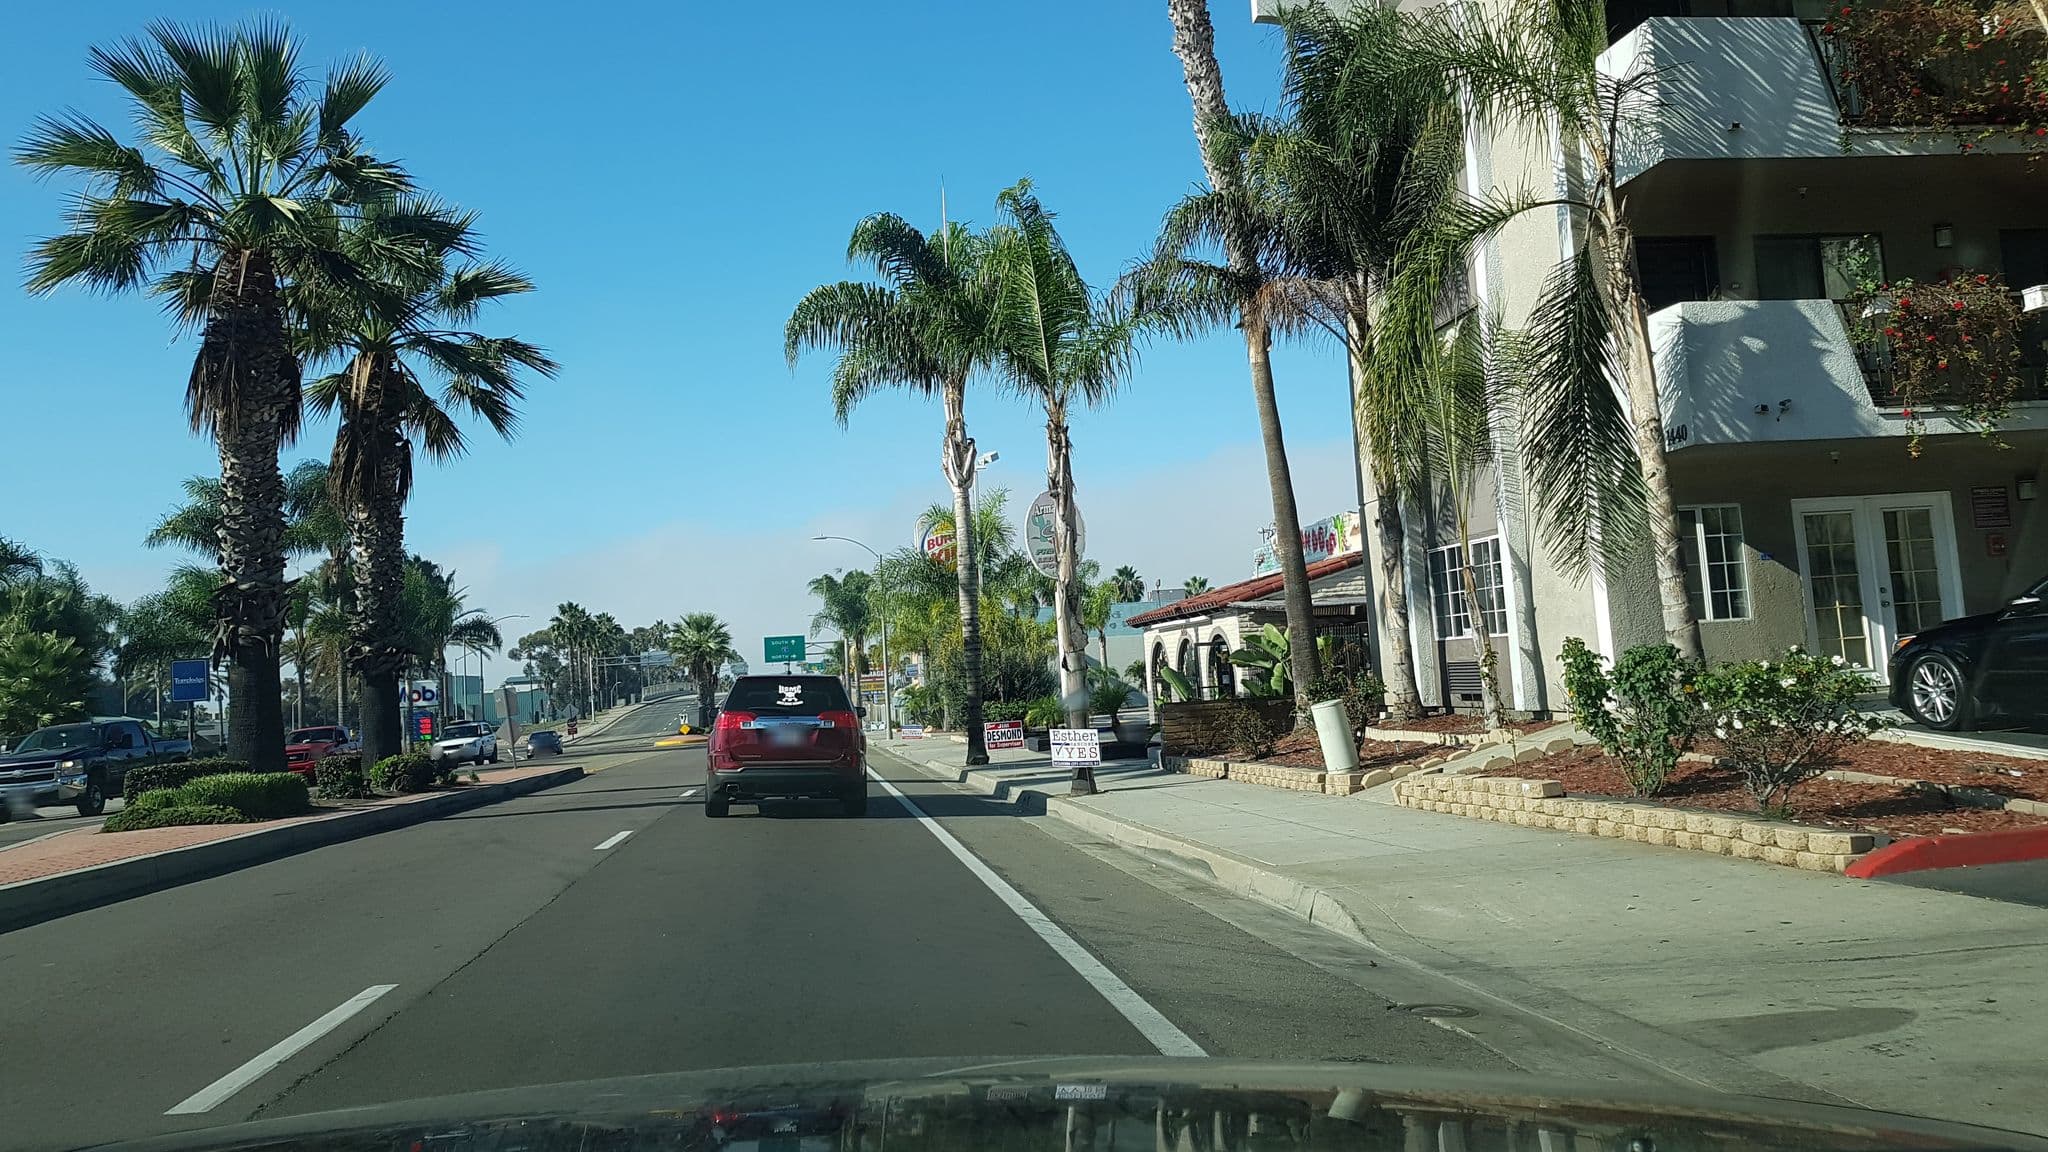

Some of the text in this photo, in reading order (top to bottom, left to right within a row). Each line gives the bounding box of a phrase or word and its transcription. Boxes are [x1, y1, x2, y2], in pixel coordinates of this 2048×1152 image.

[1667, 424, 1688, 446] 1440
[1034, 503, 1056, 517] Arma
[927, 534, 957, 551] BUR
[400, 685, 439, 702] Mobi
[778, 684, 802, 694] USMC
[987, 729, 1022, 742] DESMOND
[1051, 730, 1097, 742] Esther
[1064, 747, 1098, 759] YES
